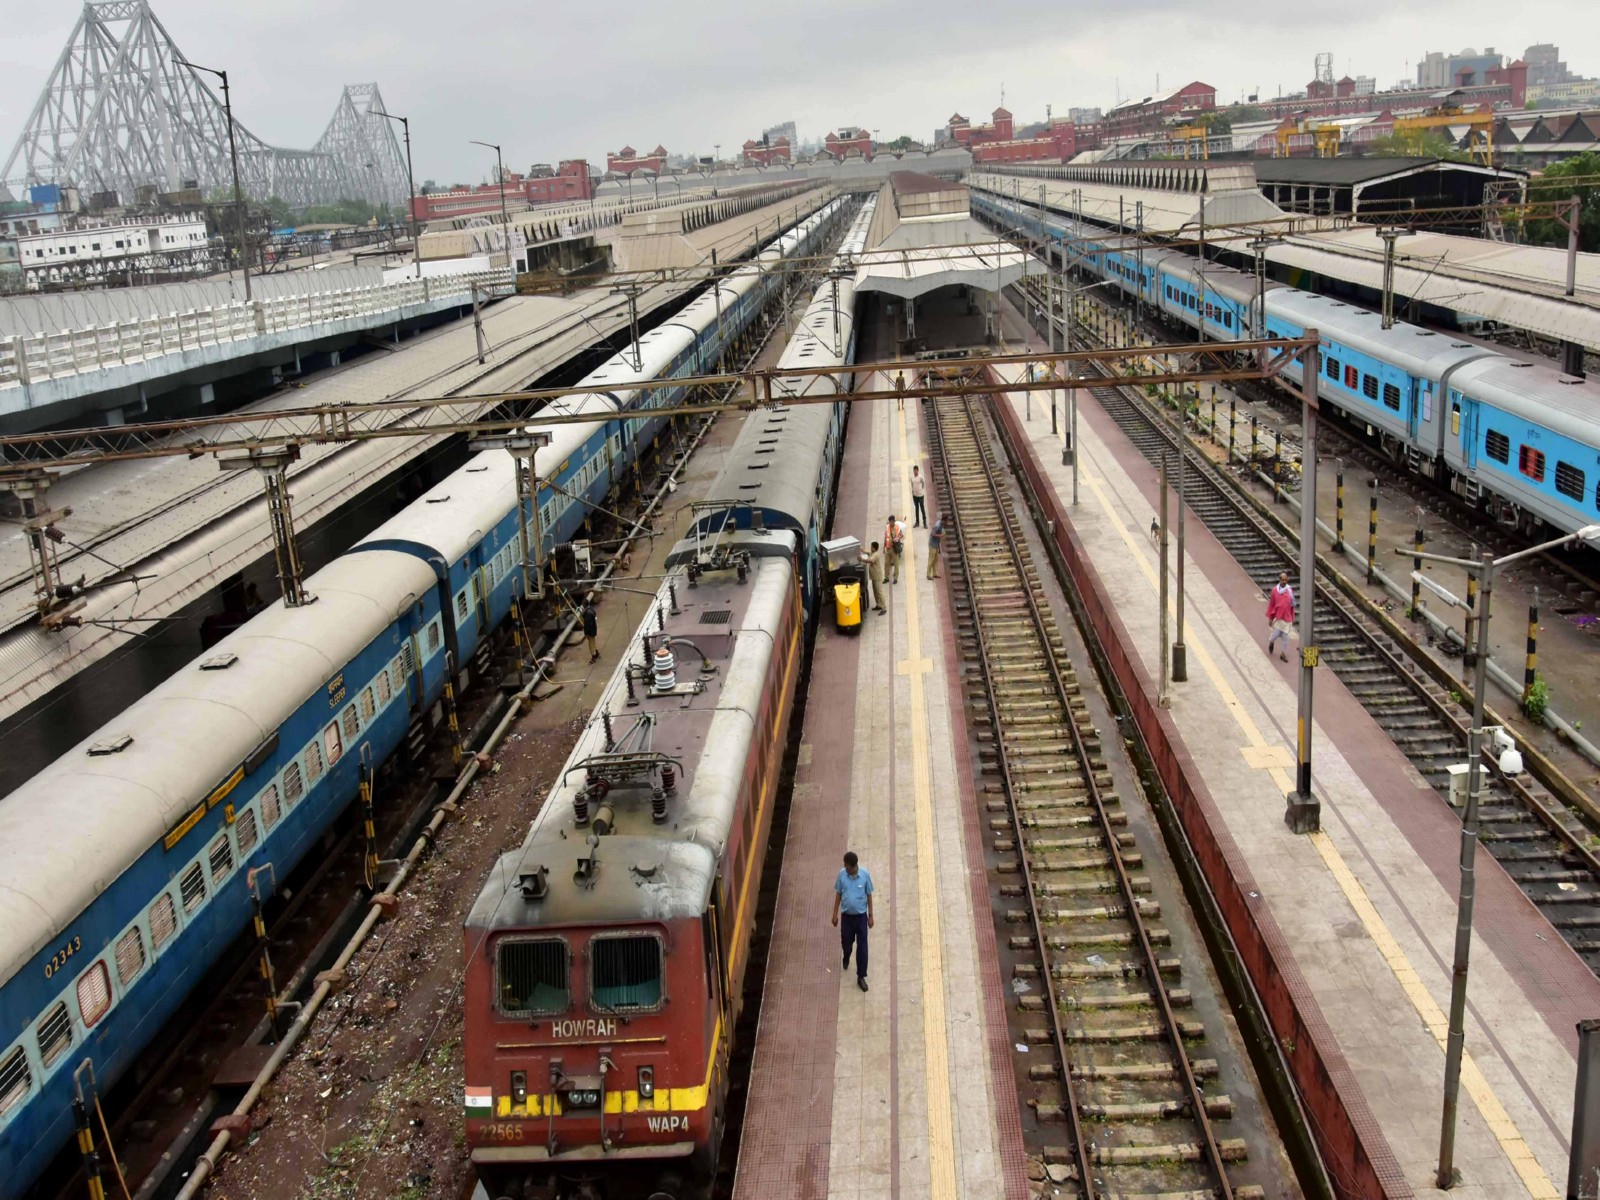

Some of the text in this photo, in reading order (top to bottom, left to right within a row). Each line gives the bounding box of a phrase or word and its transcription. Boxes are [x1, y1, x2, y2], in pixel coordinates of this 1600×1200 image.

[329, 687, 346, 709] SLEEPER
[44, 935, 81, 979] 02343
[552, 1018, 617, 1038] HOWRAH
[479, 1123, 524, 1141] 22565
